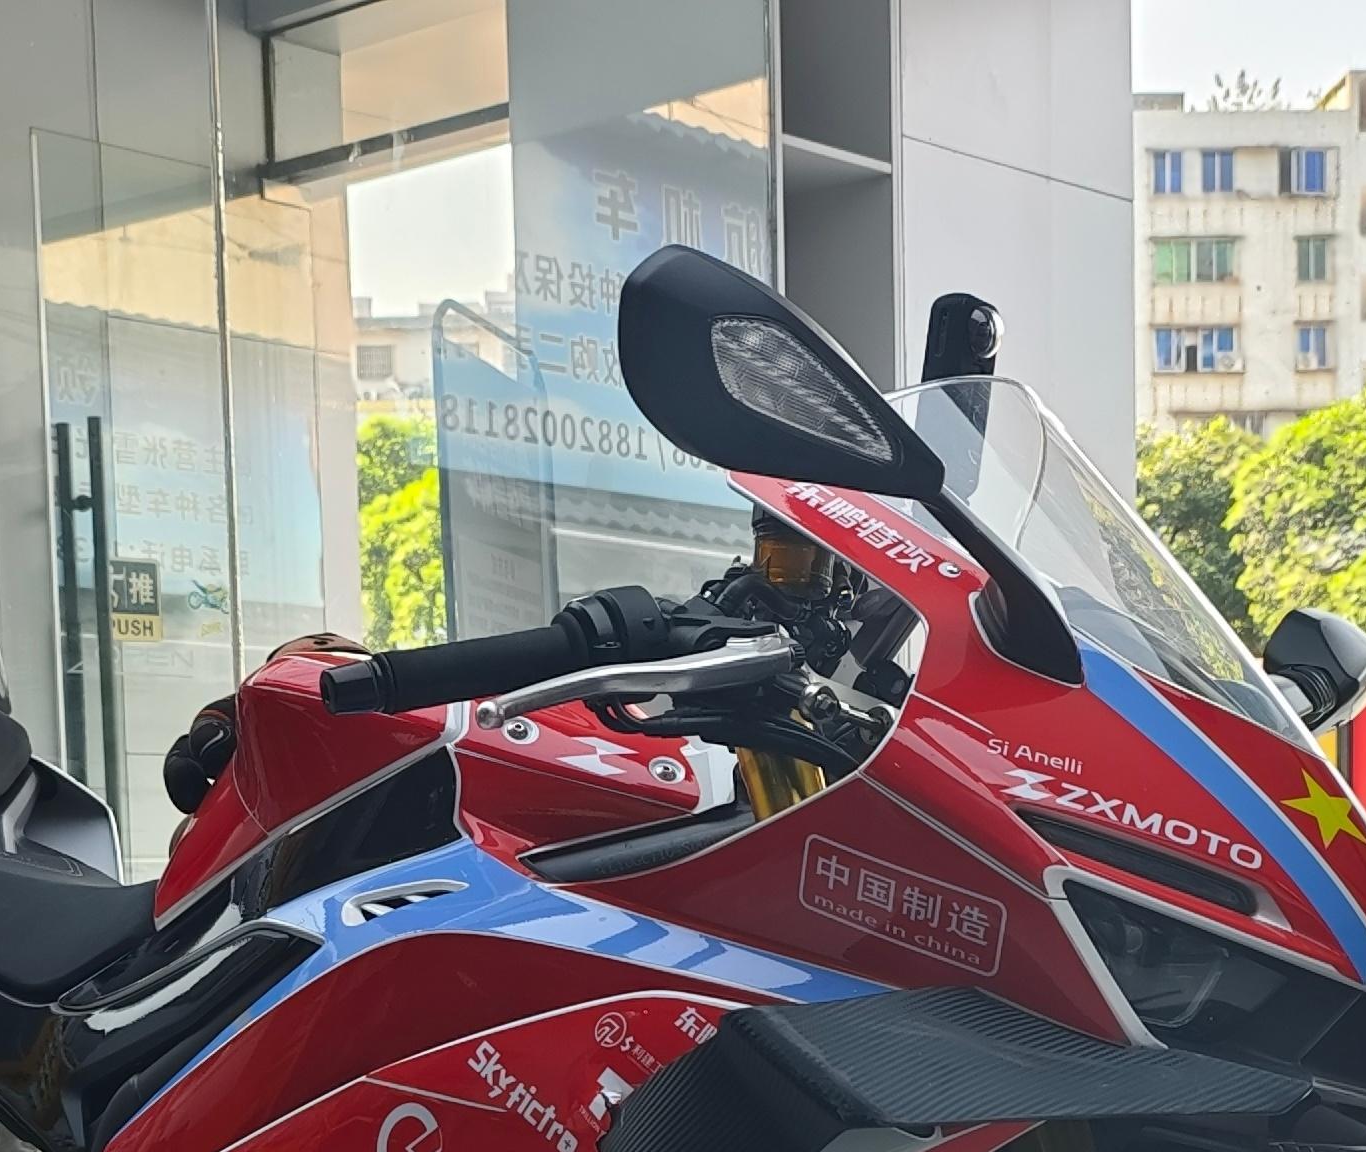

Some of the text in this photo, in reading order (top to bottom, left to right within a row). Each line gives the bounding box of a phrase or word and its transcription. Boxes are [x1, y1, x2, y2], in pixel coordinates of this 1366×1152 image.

[785, 481, 936, 574] 东鹏特饮
[128, 572, 155, 605] 推
[112, 619, 155, 637] USH
[986, 738, 1084, 776] Si Anelli
[1054, 782, 1263, 870] ZXMOTO
[813, 894, 981, 966] made in china
[815, 856, 991, 946] 中国制造
